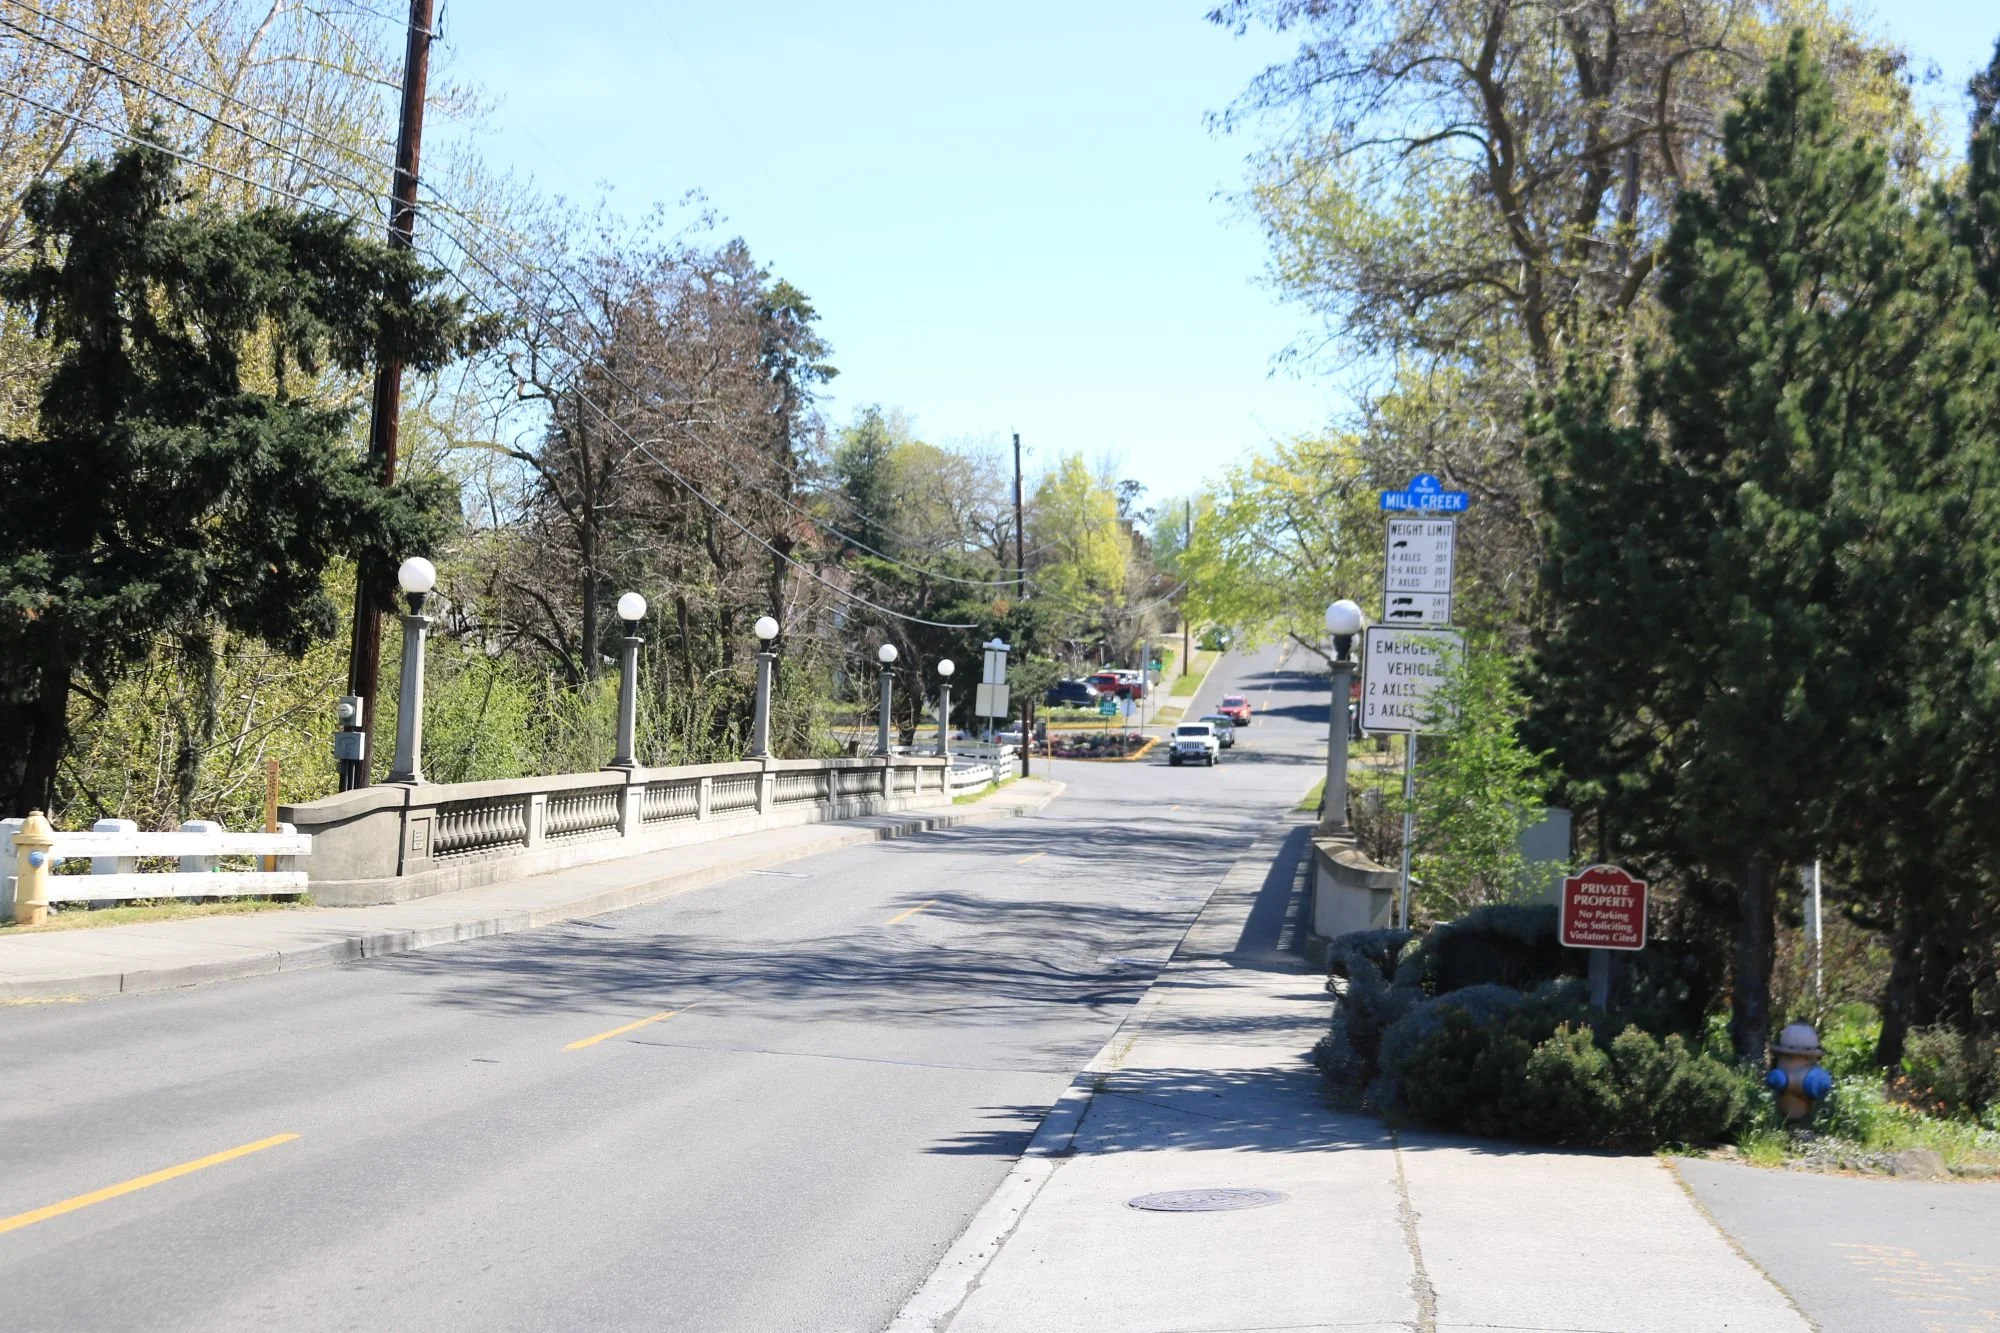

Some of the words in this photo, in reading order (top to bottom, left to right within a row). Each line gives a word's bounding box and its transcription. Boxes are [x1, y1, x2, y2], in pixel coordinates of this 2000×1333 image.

[1386, 494, 1414, 508] MILL
[1421, 495, 1461, 509] CREEK
[1391, 524, 1423, 536] WEIGHT
[1427, 525, 1451, 536] LIMIT
[1391, 553, 1396, 561] 4
[1400, 553, 1421, 562] AXLES
[1406, 566, 1427, 575] AXLES
[1398, 578, 1420, 588] AXLES
[1376, 641, 1438, 656] EMERGEN
[1369, 682, 1375, 695] 2
[1382, 683, 1415, 696] AXLES
[1369, 703, 1374, 716] 3
[1381, 704, 1414, 718] AXLES
[1580, 883, 1629, 896] PRIVATE
[1573, 894, 1635, 908] PROPERTY
[1578, 910, 1592, 918] No
[1595, 910, 1629, 922] Parking
[1573, 920, 1587, 929] No
[1590, 921, 1633, 933] Soliciting
[1569, 930, 1609, 941] Violators
[1612, 933, 1637, 942] Cited
